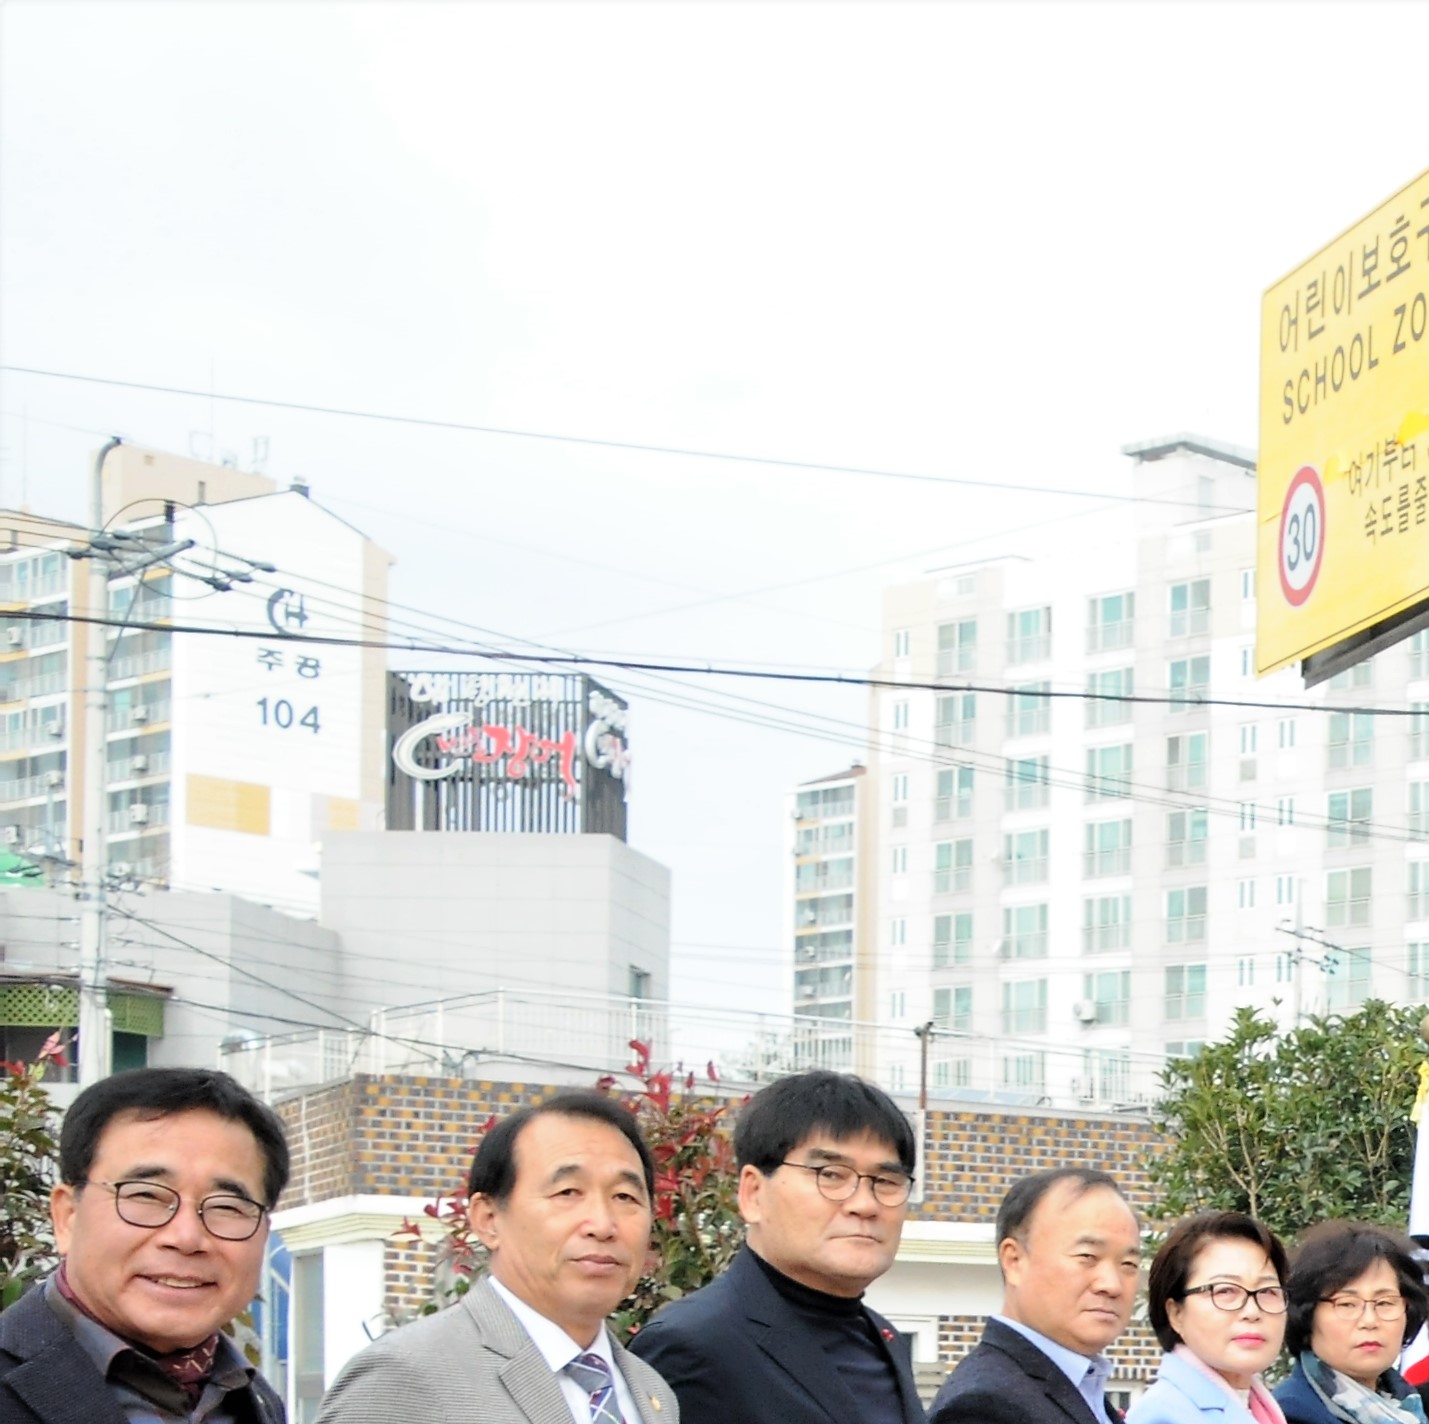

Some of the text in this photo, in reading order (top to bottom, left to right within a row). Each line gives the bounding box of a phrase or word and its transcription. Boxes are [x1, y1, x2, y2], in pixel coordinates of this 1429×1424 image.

[1282, 326, 1379, 426] SCHOOL
[1286, 502, 1316, 572] 30
[256, 697, 321, 735] 104
